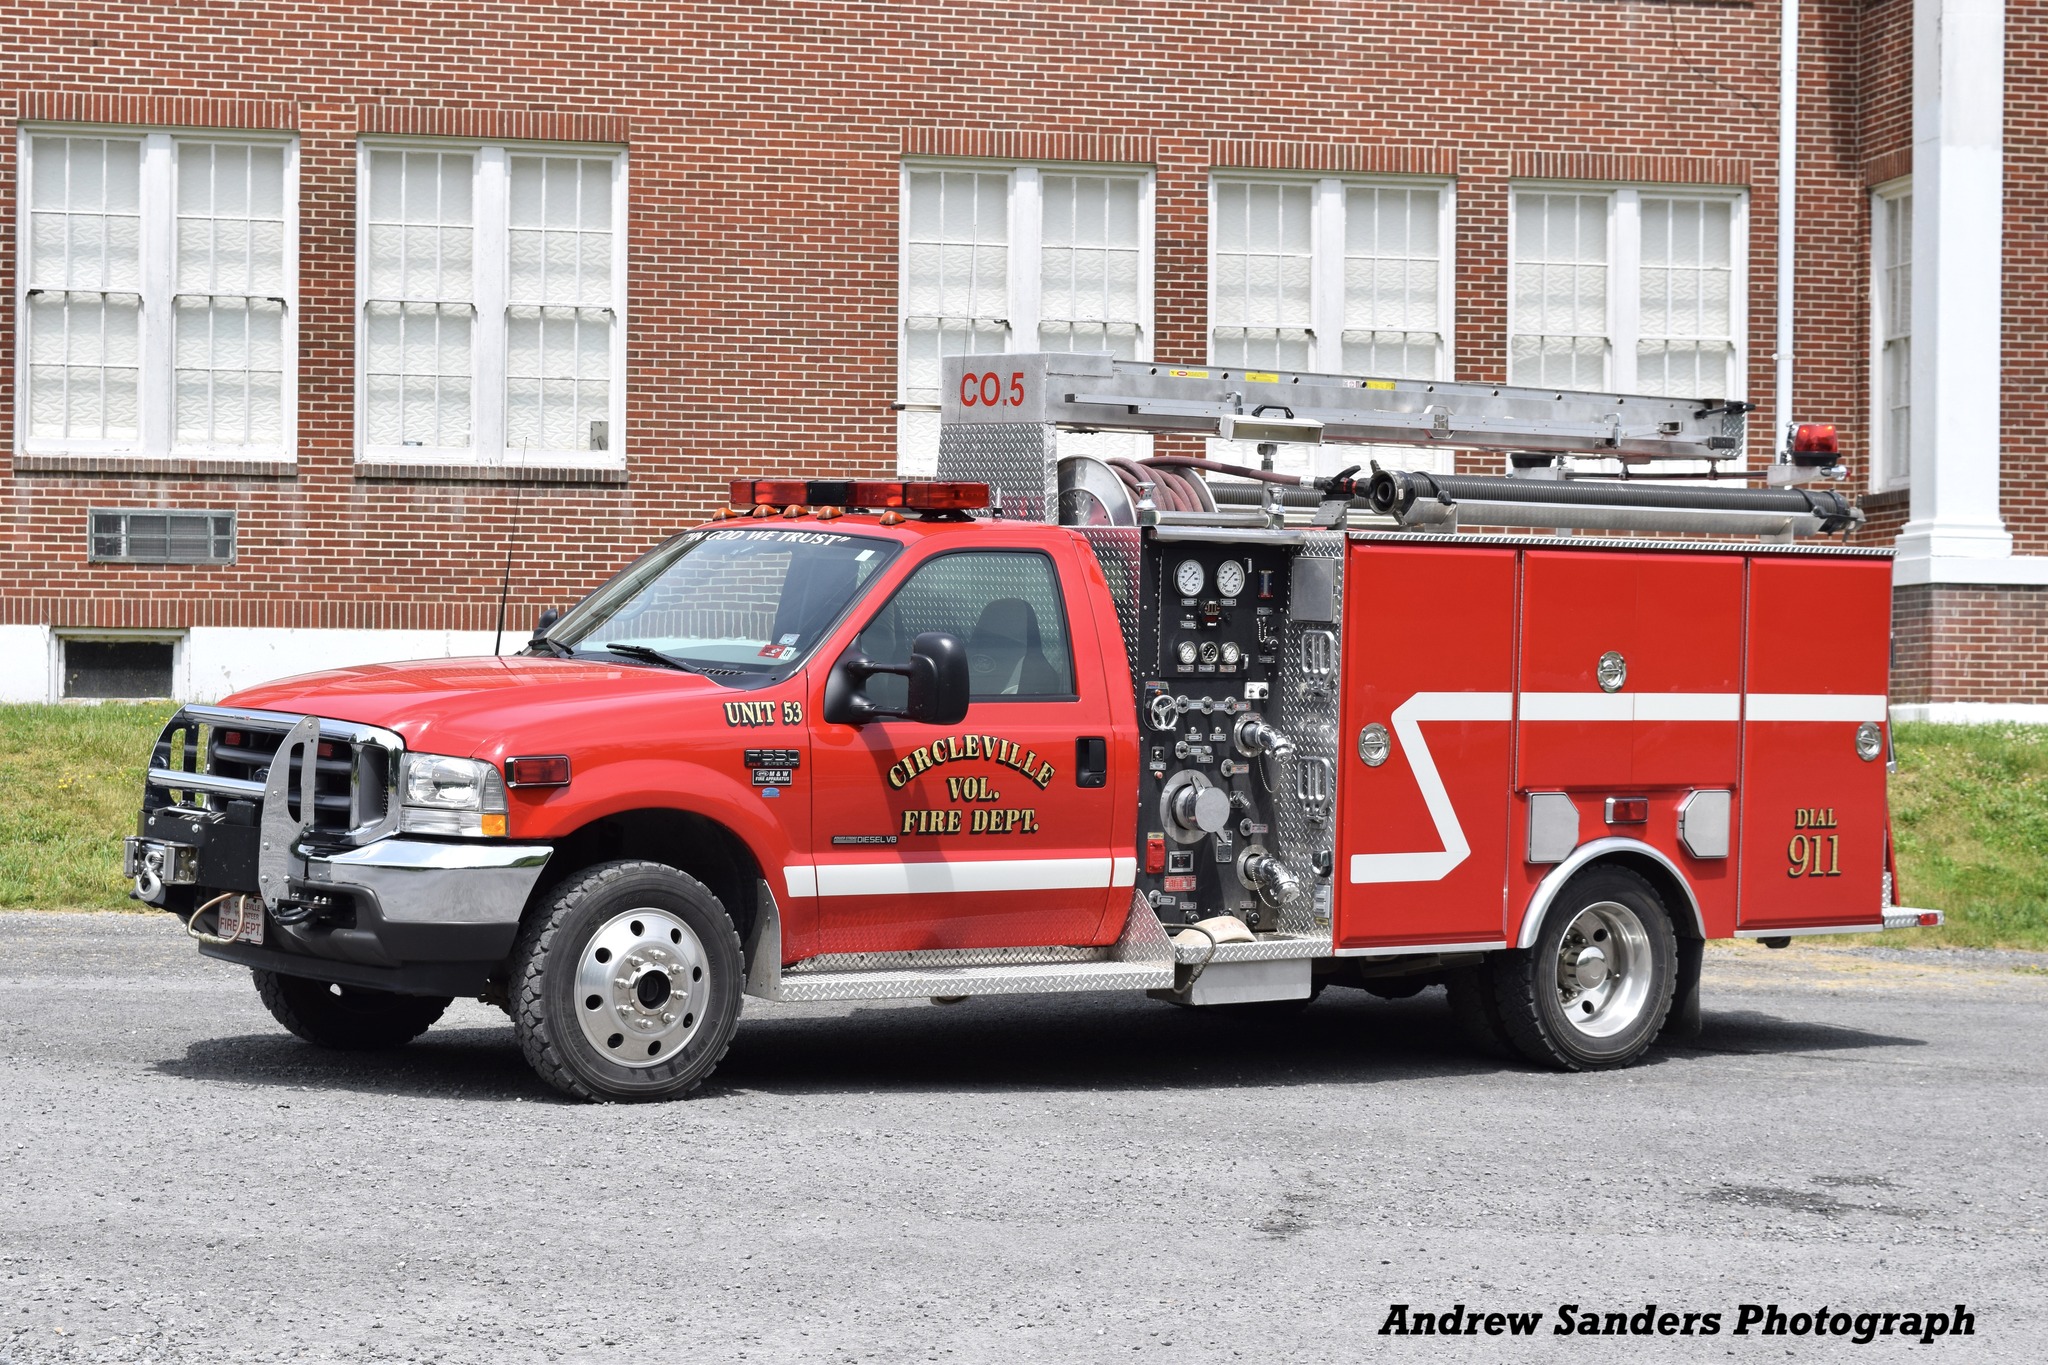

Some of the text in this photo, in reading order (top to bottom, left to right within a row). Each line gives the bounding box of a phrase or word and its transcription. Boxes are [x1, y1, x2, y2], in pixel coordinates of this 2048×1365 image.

[960, 371, 1025, 408] CO.5
[706, 530, 746, 541] GOD
[746, 530, 780, 541] WE
[723, 700, 804, 727] UNIT 53
[888, 734, 1057, 790] CIRCLEVILLE
[947, 777, 1000, 800] VOL.
[900, 809, 1040, 836] FIRE DEPT.
[1795, 807, 1838, 829] DIAL
[857, 836, 886, 844] DIESEL
[886, 836, 898, 844] V8
[1787, 834, 1842, 878] 911
[220, 917, 238, 932] FIRE
